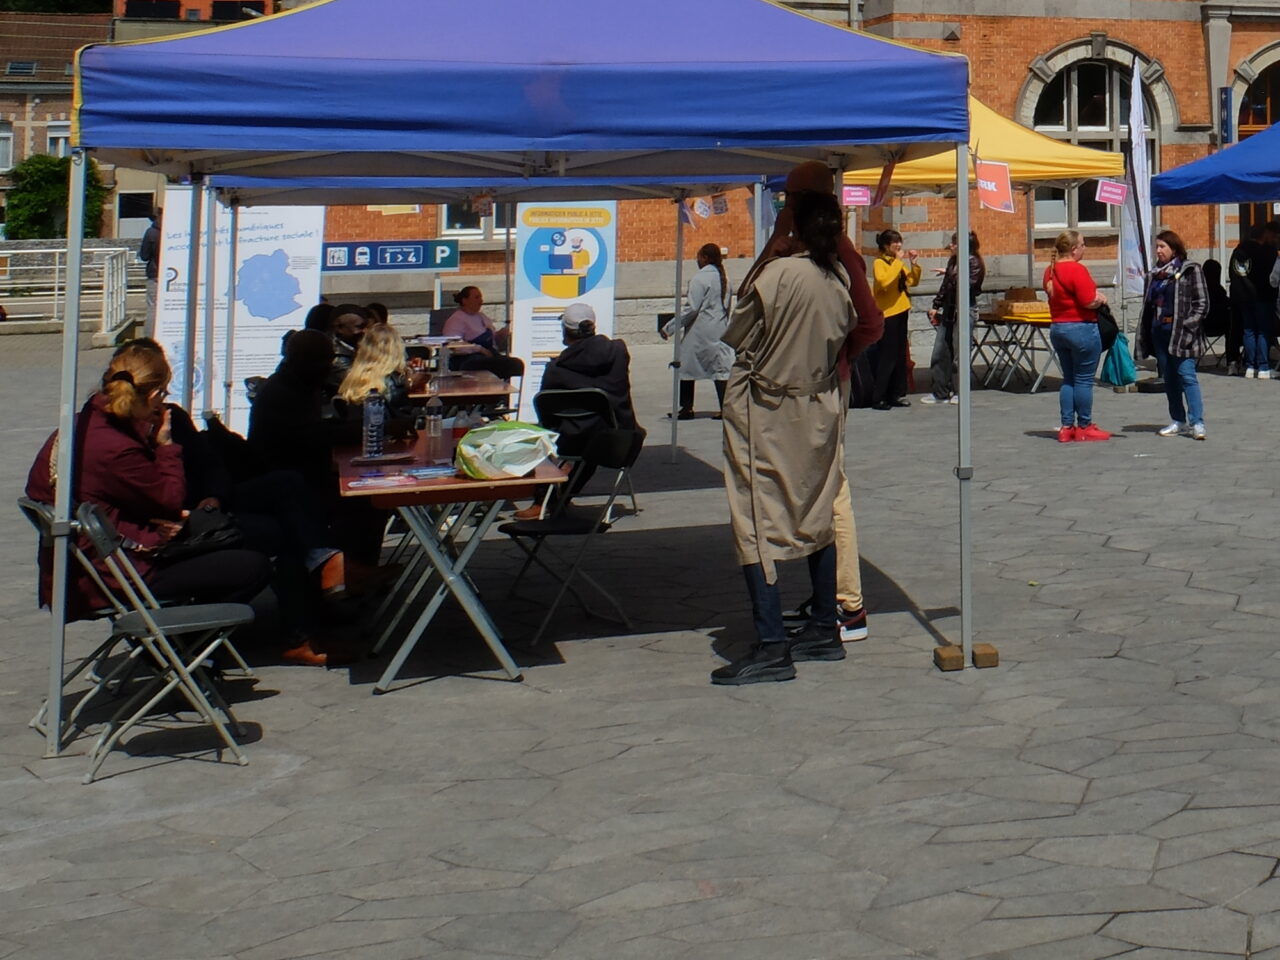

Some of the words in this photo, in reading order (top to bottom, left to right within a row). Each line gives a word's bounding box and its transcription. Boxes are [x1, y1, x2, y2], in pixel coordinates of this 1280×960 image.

[237, 222, 284, 233] umériques
[384, 253, 390, 263] 1
[407, 252, 416, 262] 4
[435, 246, 450, 264] P
